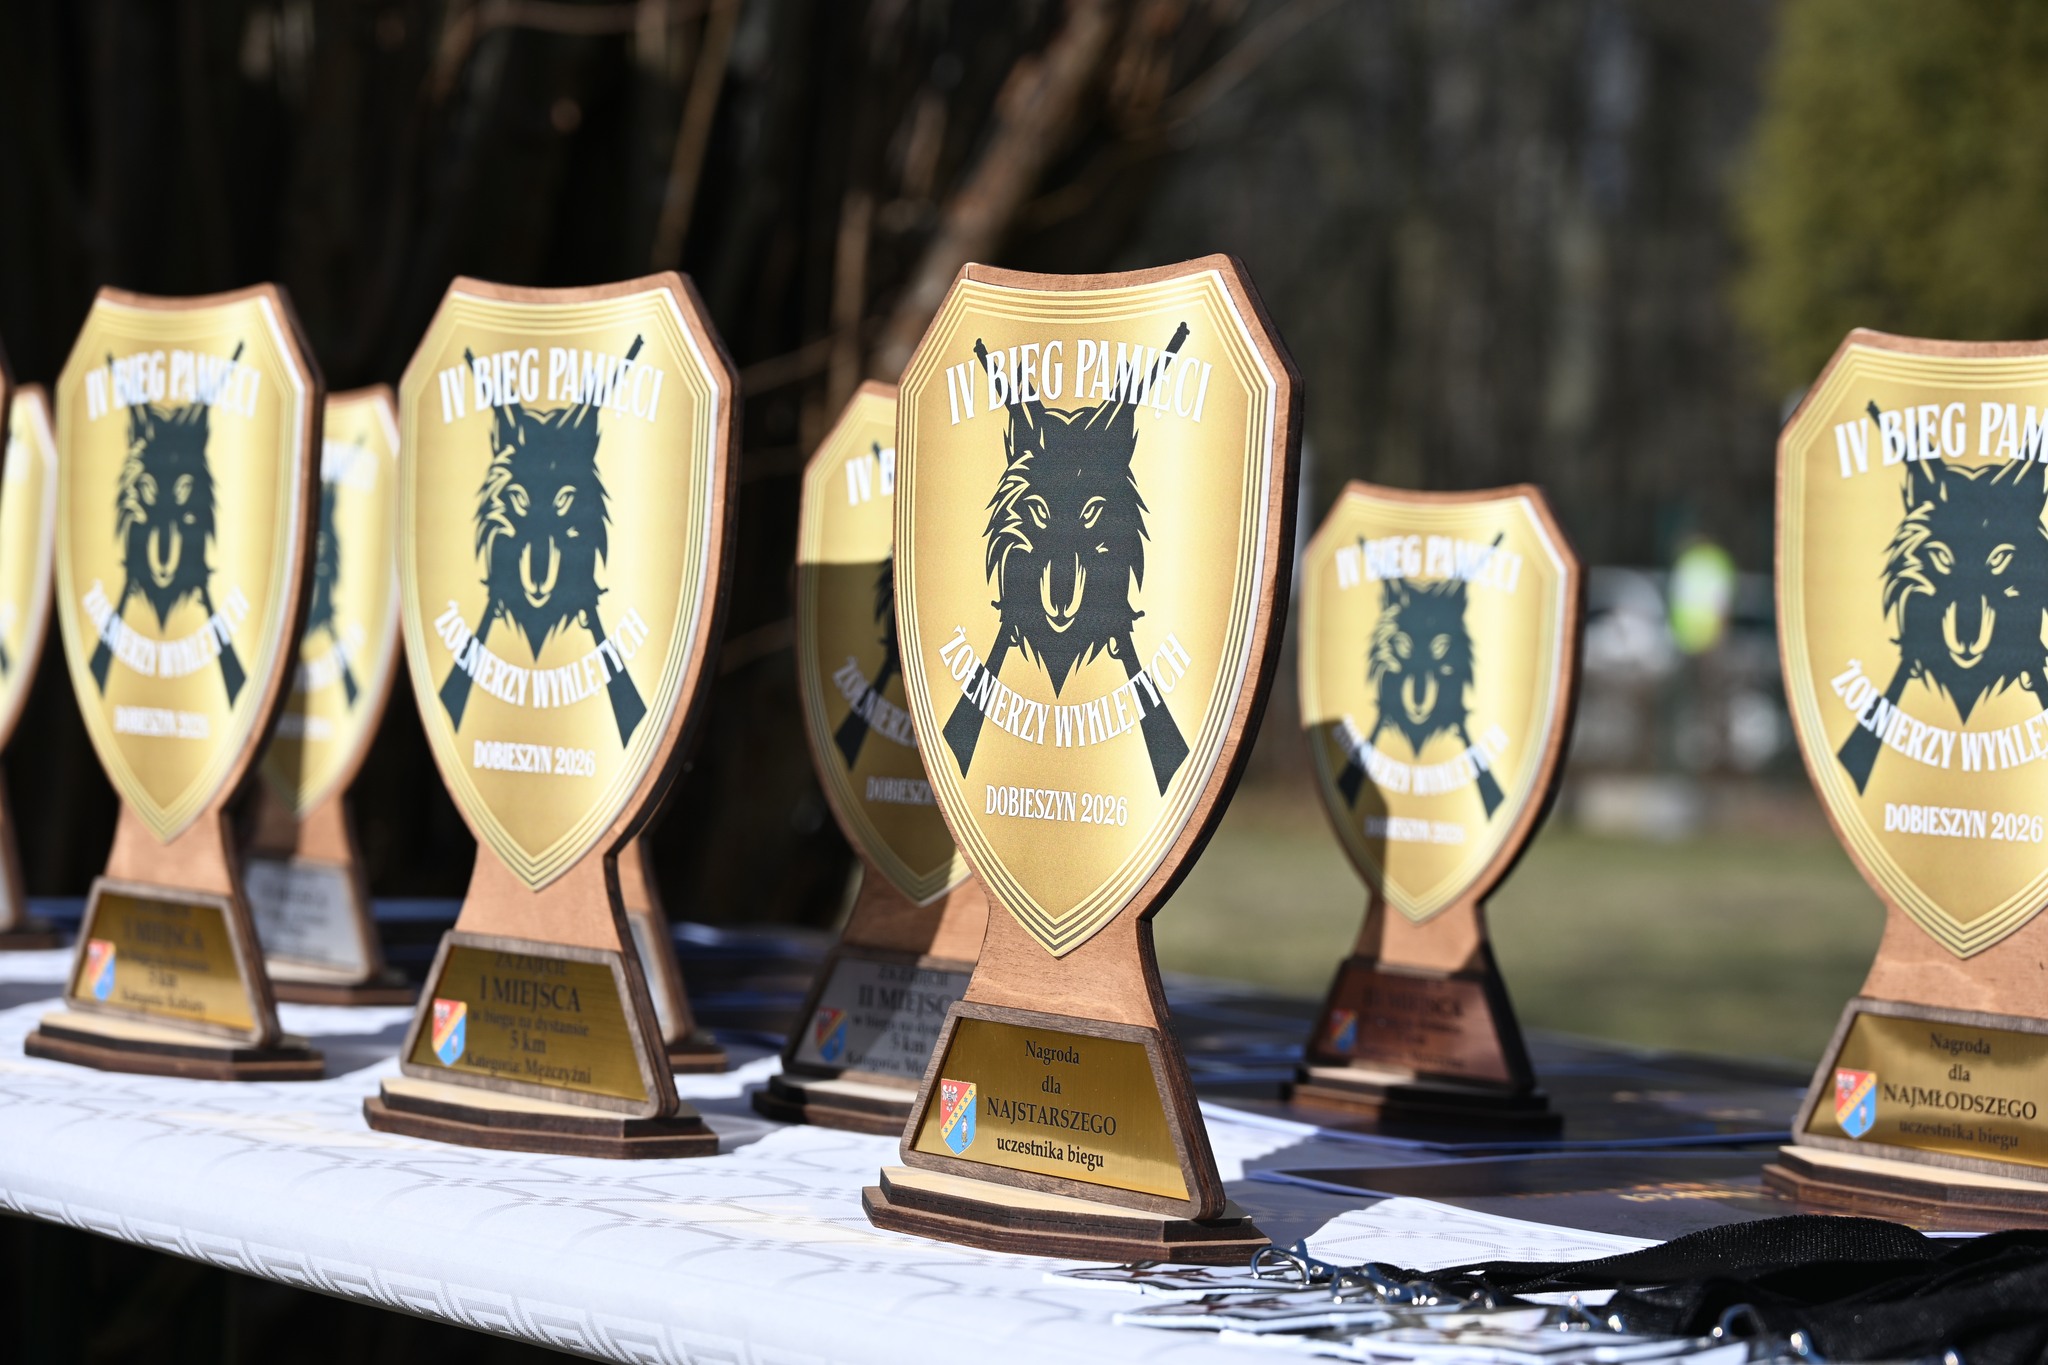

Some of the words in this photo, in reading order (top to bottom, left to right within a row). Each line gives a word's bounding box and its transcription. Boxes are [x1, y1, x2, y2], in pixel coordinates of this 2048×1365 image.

[438, 364, 466, 424] IV
[473, 348, 539, 411] BIEG
[548, 347, 664, 423] PAMIĘCI
[946, 359, 975, 426] IV
[986, 340, 1063, 412] BIEG
[1074, 339, 1213, 423] PAMIĘCI
[1834, 417, 1869, 479] IV
[1878, 402, 1967, 467] BIEG
[939, 624, 1051, 746] ŻOŁNIERZY
[1053, 632, 1192, 748] WYKLĘTYCH
[1830, 658, 1957, 770] ŻOŁNIERZY
[1960, 708, 2048, 773] WYKLĘ
[555, 747, 596, 777] 2026
[985, 784, 1077, 822] DOBIESZYN
[1080, 793, 1128, 827] 2026
[1884, 802, 1986, 839] DOBIESZYN
[1990, 811, 2044, 844] 2026
[480, 974, 487, 1001] I
[493, 976, 582, 1013] MIEJSCA
[879, 987, 951, 1018] MIEJSC
[511, 1030, 519, 1049] 5
[522, 1031, 547, 1054] km
[1025, 1039, 1080, 1066] Nagroda
[1930, 1032, 1991, 1057] Nagroda
[1041, 1075, 1061, 1095] dla
[1948, 1063, 1971, 1083] dla
[987, 1097, 1117, 1136] NAJSTARSZEGO
[1883, 1083, 2038, 1121] NAJMŁODSZEGO
[996, 1136, 1064, 1162] uczestnika
[1067, 1144, 1105, 1172] biegu
[1899, 1120, 1974, 1142] uczestnika
[1978, 1128, 2019, 1151] biegu
